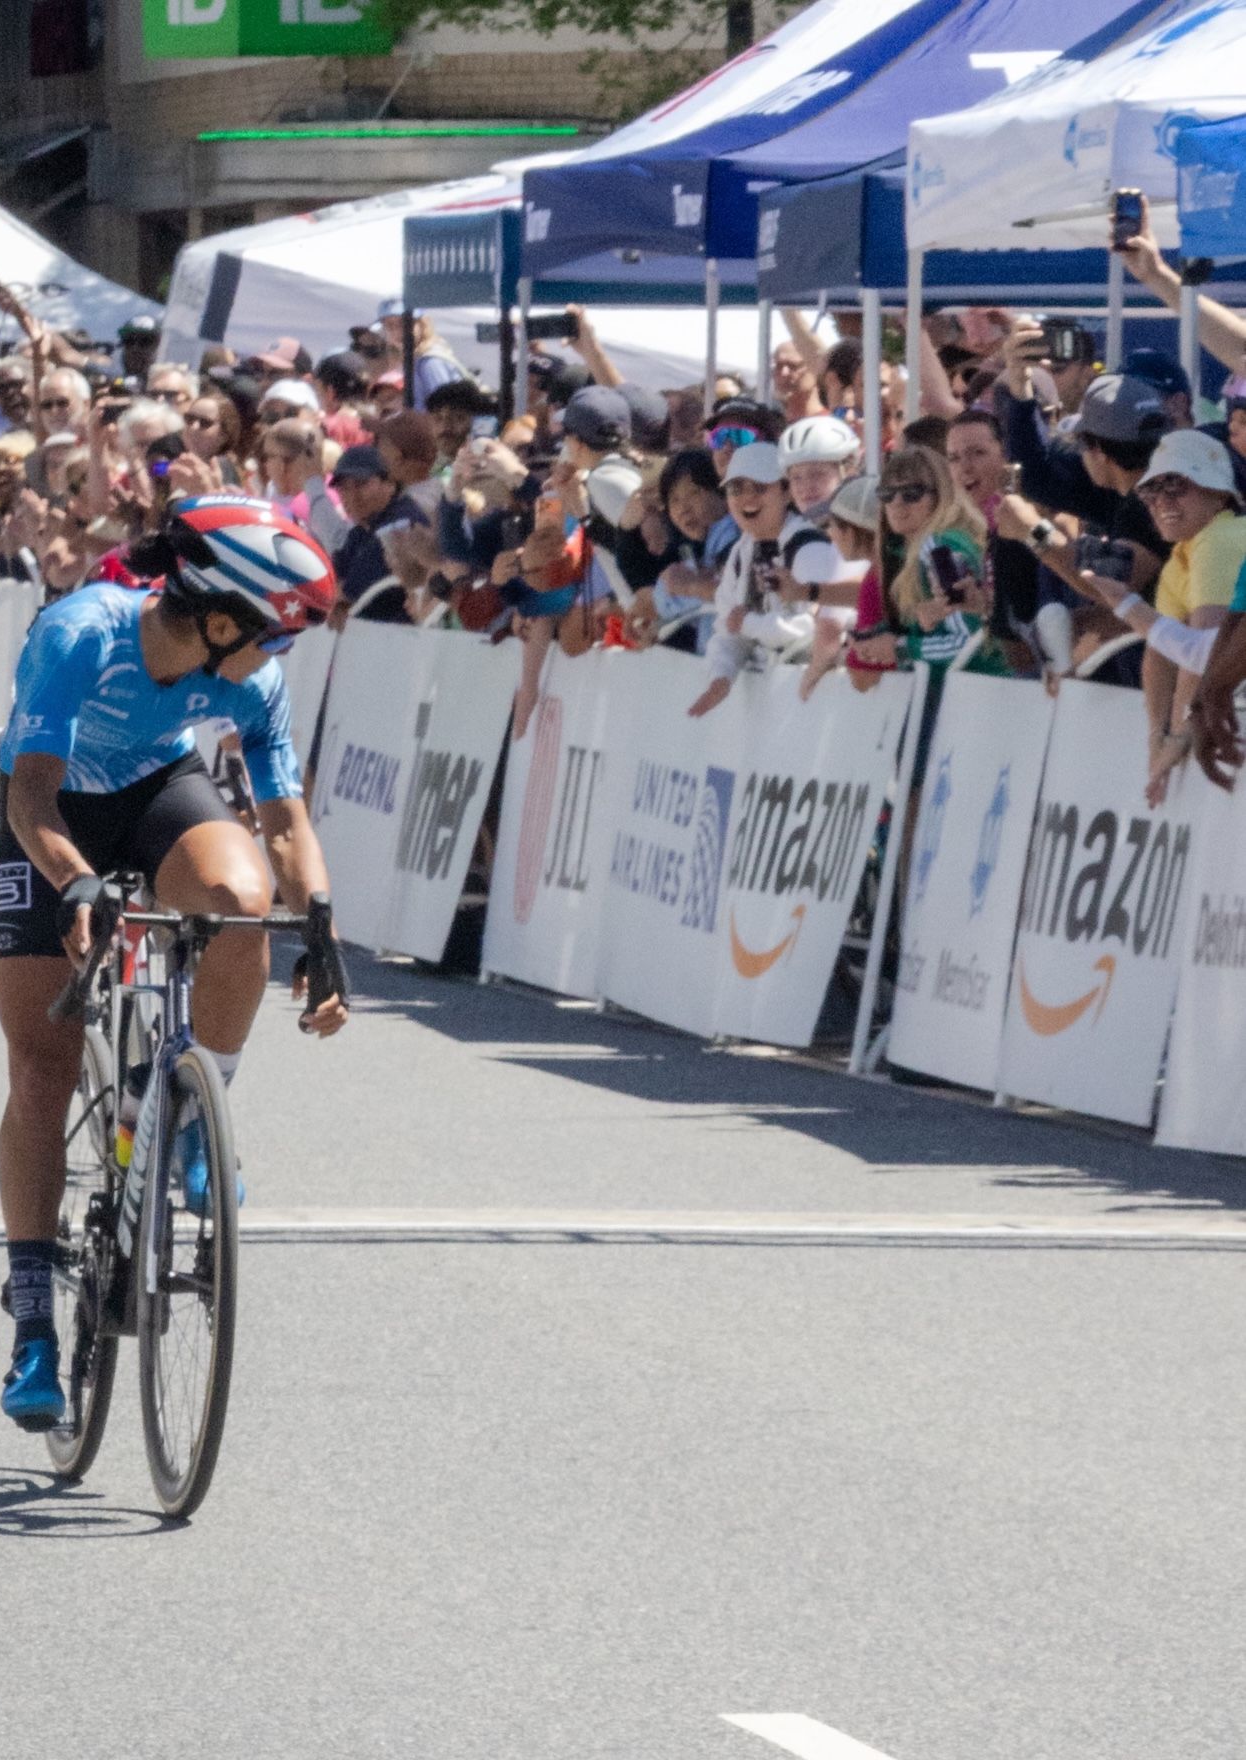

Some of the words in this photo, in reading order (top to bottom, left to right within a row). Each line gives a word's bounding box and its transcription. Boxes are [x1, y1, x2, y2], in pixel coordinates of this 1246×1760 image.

[545, 746, 600, 892] JLL
[633, 758, 697, 827] UNITED
[728, 772, 870, 902] amazon
[611, 830, 684, 905] AIRLINES
